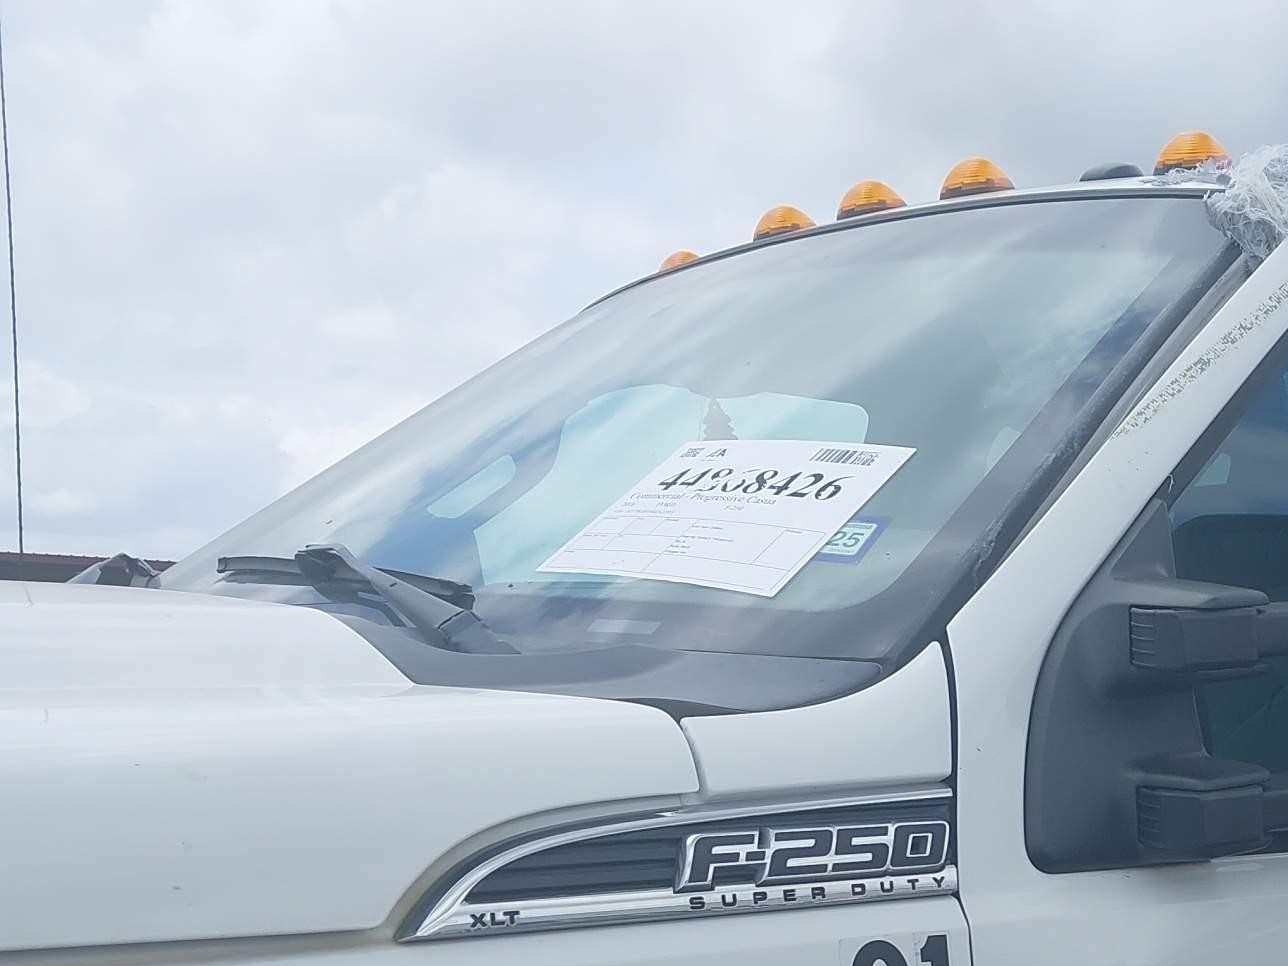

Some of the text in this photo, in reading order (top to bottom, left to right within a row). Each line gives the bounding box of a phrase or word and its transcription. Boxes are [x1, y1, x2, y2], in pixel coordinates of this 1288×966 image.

[657, 467, 855, 501] 44868426
[826, 531, 865, 548] 25
[674, 820, 950, 893] F-250
[689, 875, 947, 911] SUPER DUTY
[469, 910, 521, 929] XLT
